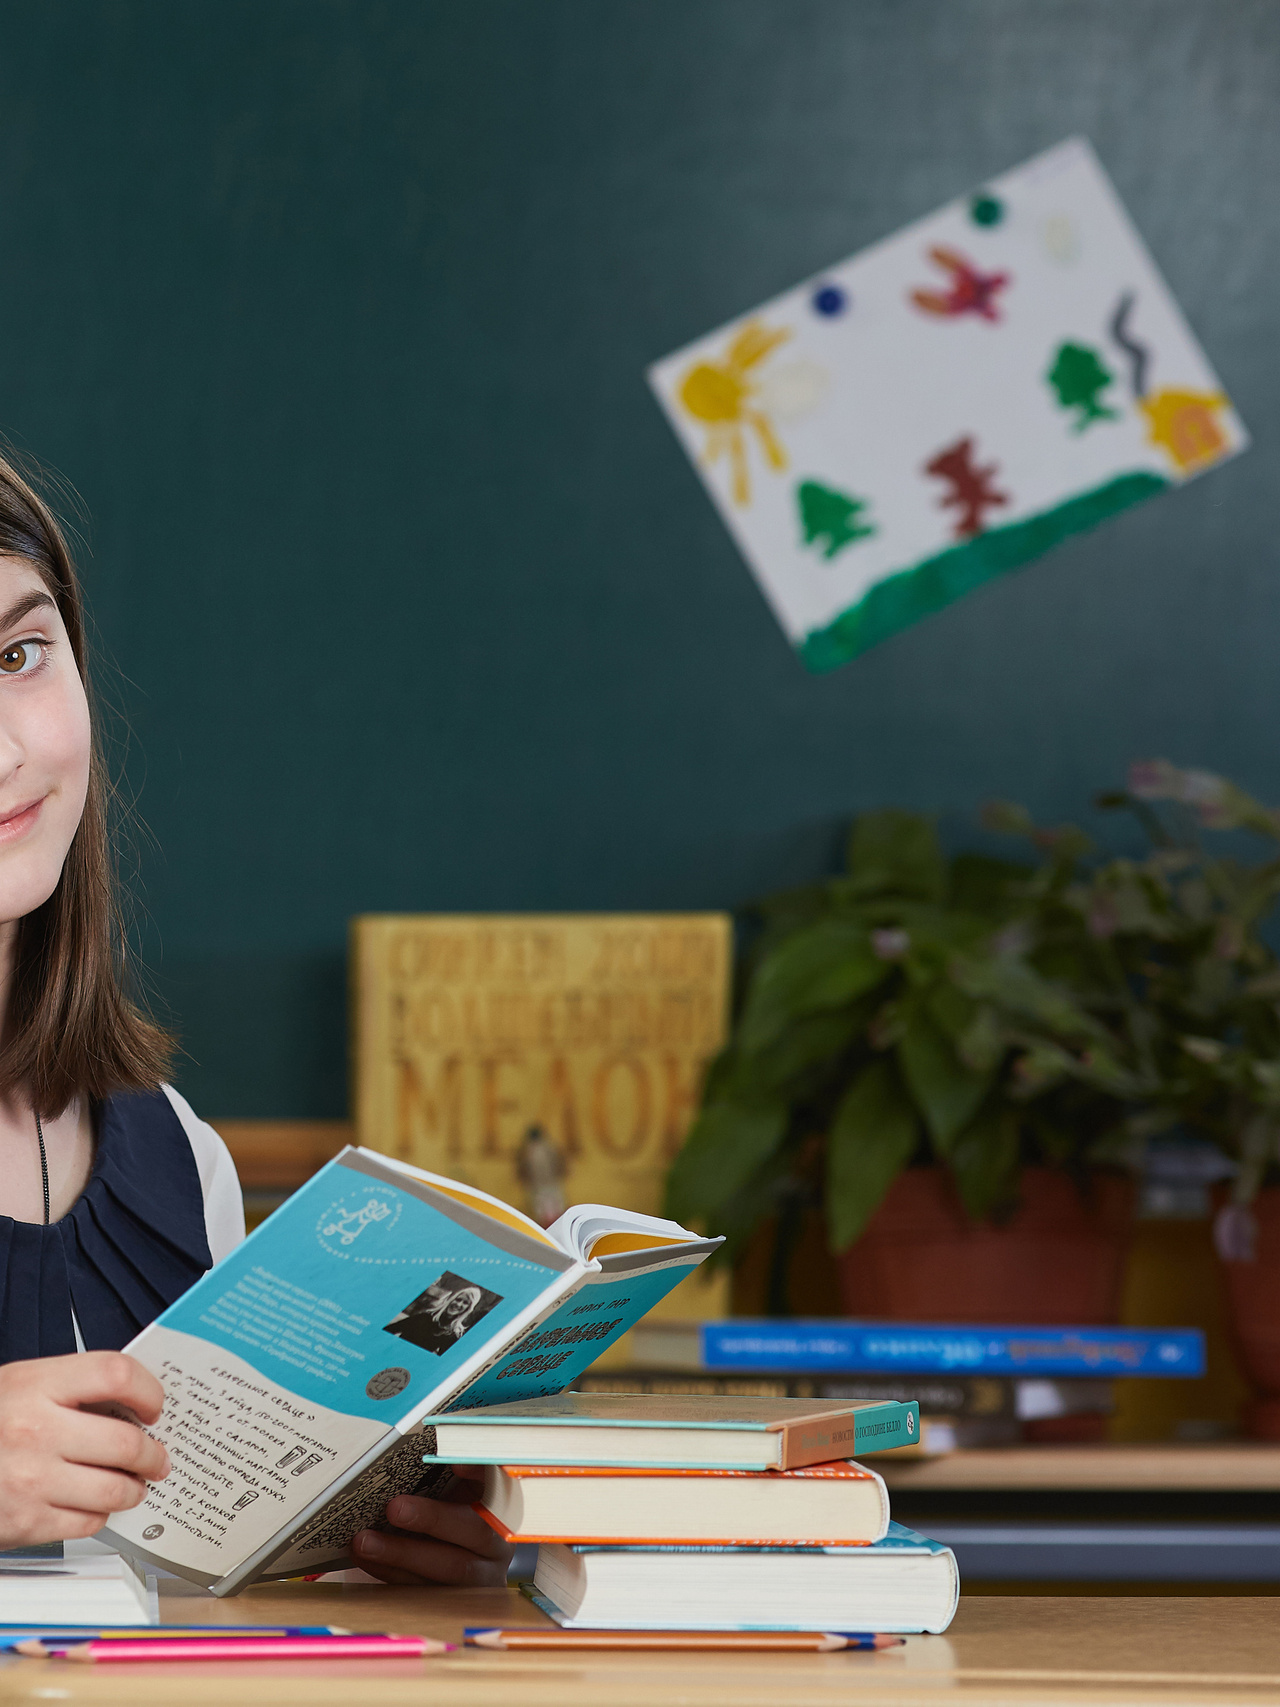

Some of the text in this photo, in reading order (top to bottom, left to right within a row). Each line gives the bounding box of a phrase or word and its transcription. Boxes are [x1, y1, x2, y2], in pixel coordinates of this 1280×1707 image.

[567, 1298, 631, 1316] МАРИЯ ПАРР
[496, 1351, 575, 1380] СЕРДЦЕ
[163, 1392, 180, 1407] ЙТЕ
[225, 1431, 268, 1458] САХАРОМ,
[169, 1446, 233, 1490] ПЕРЕМЕШАЙТЕ.
[173, 1431, 226, 1466] ПОСЛЕДНЮЮ
[260, 1485, 286, 1502] МУКУ.
[175, 1419, 248, 1460] РАСТОПЛЕННЫЙ
[244, 1459, 289, 1488] МАРГАРИН,
[171, 1463, 219, 1498] ОЛУЧИТЬСЯ
[197, 1498, 236, 1522] КОМКОВ.
[145, 1527, 161, 1539] 6+
